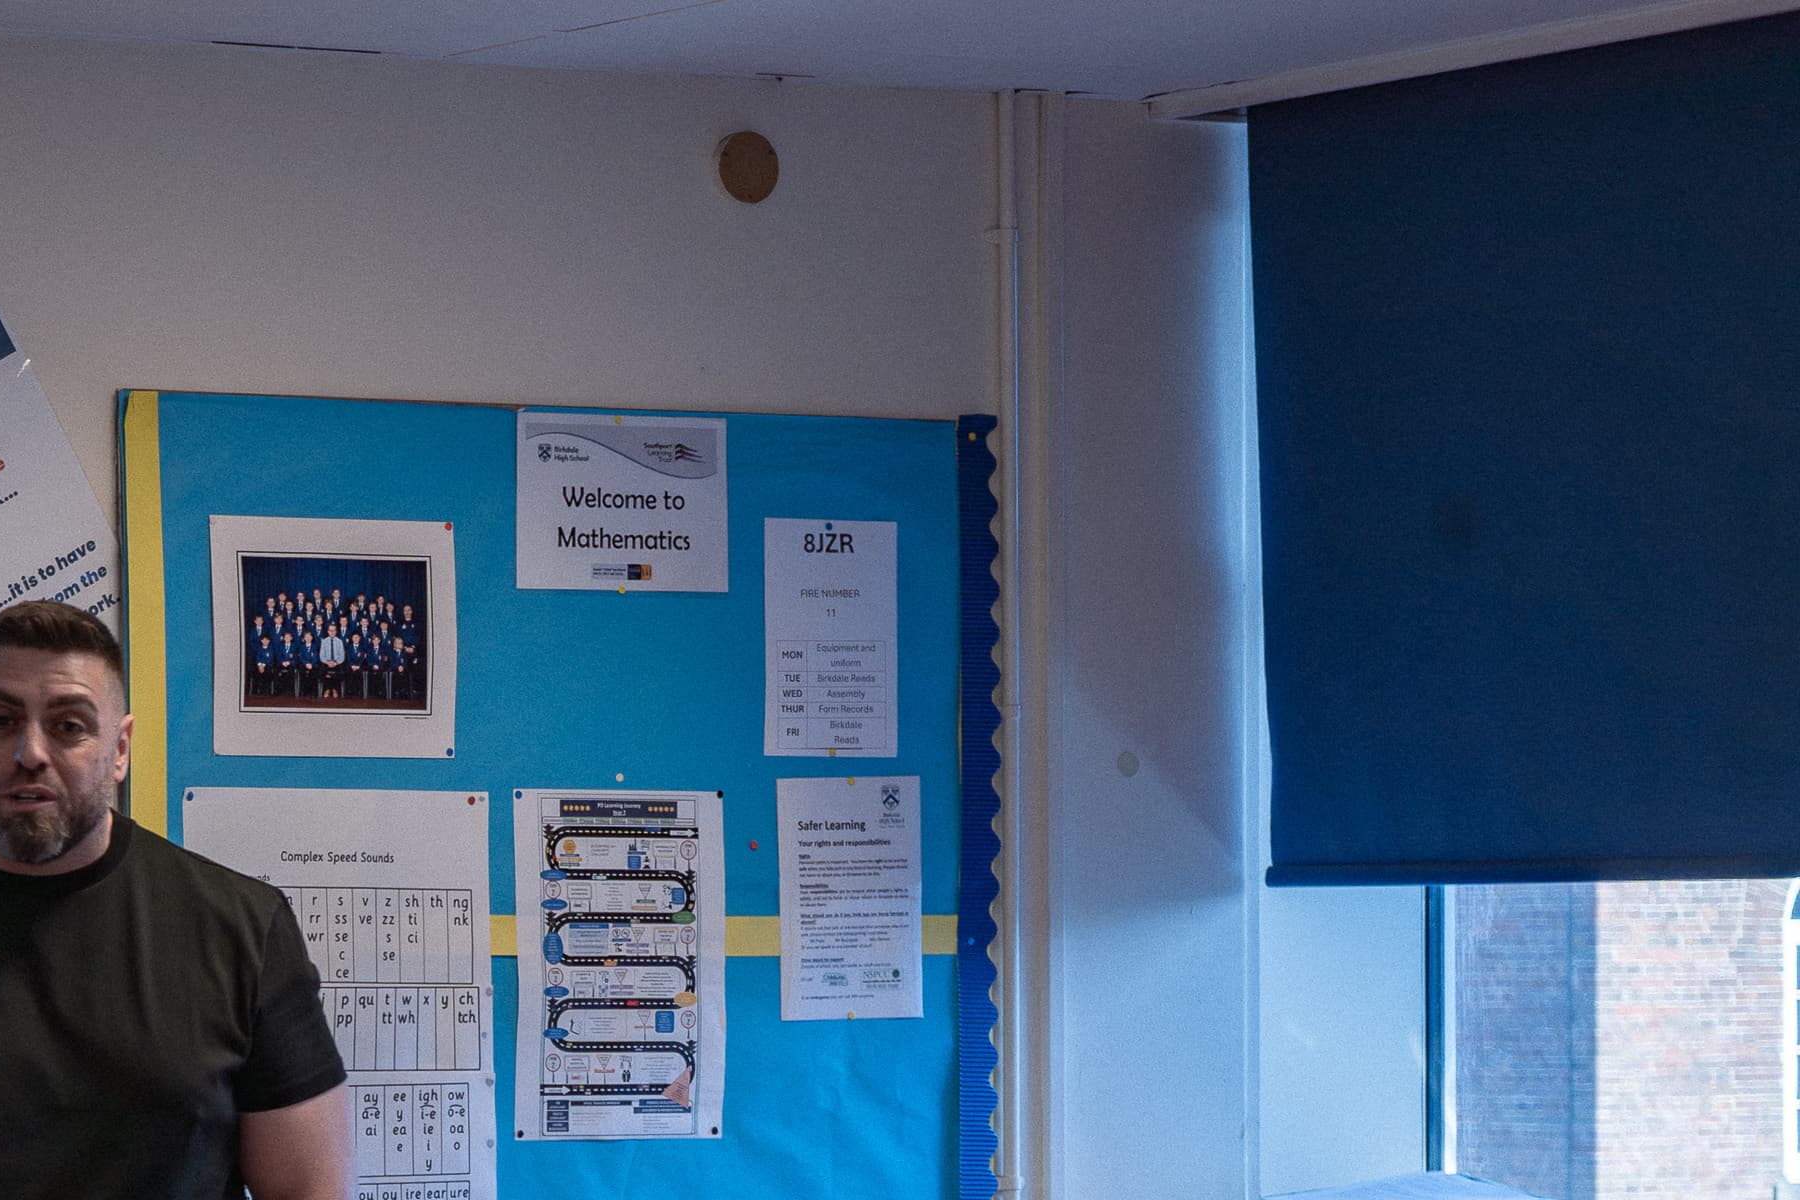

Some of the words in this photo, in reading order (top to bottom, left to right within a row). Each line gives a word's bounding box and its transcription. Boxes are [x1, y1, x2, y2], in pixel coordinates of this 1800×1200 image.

[562, 486, 657, 509] Welcome
[664, 491, 685, 510] to
[558, 527, 690, 551] Mathematics
[804, 534, 854, 553] 8JZR
[21, 576, 38, 591] is
[38, 565, 56, 581] to
[55, 540, 96, 570] have
[80, 566, 107, 587] the
[801, 589, 818, 598] FIRE
[822, 589, 860, 598] NUMBER
[826, 608, 836, 617] 11
[782, 650, 803, 659] MON
[784, 674, 801, 682] TUE
[782, 690, 803, 698] WED
[826, 690, 866, 700] Assembly
[781, 705, 804, 713] THUR
[818, 705, 839, 713] Form
[840, 705, 874, 714] Records
[786, 728, 800, 736] FRI
[798, 820, 822, 831] Safer
[825, 820, 866, 832] Learning
[814, 840, 832, 848] rights
[280, 851, 324, 864] Complex
[328, 852, 357, 864] Speed
[360, 852, 394, 864] Sounds
[312, 896, 318, 906] r
[338, 896, 344, 906] s
[362, 897, 369, 906] v
[385, 897, 392, 907] z
[405, 894, 419, 908] sh
[430, 896, 443, 908] th
[453, 898, 469, 912] ng
[309, 914, 321, 924] rr
[335, 914, 347, 924] ss
[359, 914, 372, 924] ve
[382, 915, 394, 925] zz
[408, 914, 418, 926] ti
[454, 914, 469, 926] nk
[307, 932, 324, 942] wr
[335, 932, 348, 942] se
[386, 934, 392, 943] s
[408, 932, 418, 944] ci
[338, 950, 345, 960] c
[382, 951, 396, 961] se
[336, 968, 350, 978] ce
[341, 995, 349, 1010] p
[358, 995, 374, 1009] qu
[385, 993, 390, 1006] t
[402, 995, 412, 1006] w
[423, 995, 430, 1005] x
[441, 994, 449, 1009] y
[459, 992, 474, 1006] ch
[337, 1014, 352, 1027] pp
[382, 1012, 392, 1024] tt
[398, 1010, 415, 1024] wh
[458, 1010, 476, 1024] tch
[364, 1094, 378, 1106] ay
[393, 1092, 406, 1102] ee
[418, 1088, 438, 1104] igh
[448, 1091, 464, 1100] ow
[396, 1109, 403, 1122] y
[365, 1124, 378, 1136] ai
[392, 1126, 406, 1136] ea
[423, 1124, 434, 1134] ie
[450, 1125, 464, 1134] oa
[396, 1143, 403, 1152] e
[454, 1142, 460, 1150] o
[426, 1160, 432, 1172] y
[405, 1188, 422, 1200] ire
[426, 1190, 446, 1200] ear
[450, 1188, 470, 1198] ure
